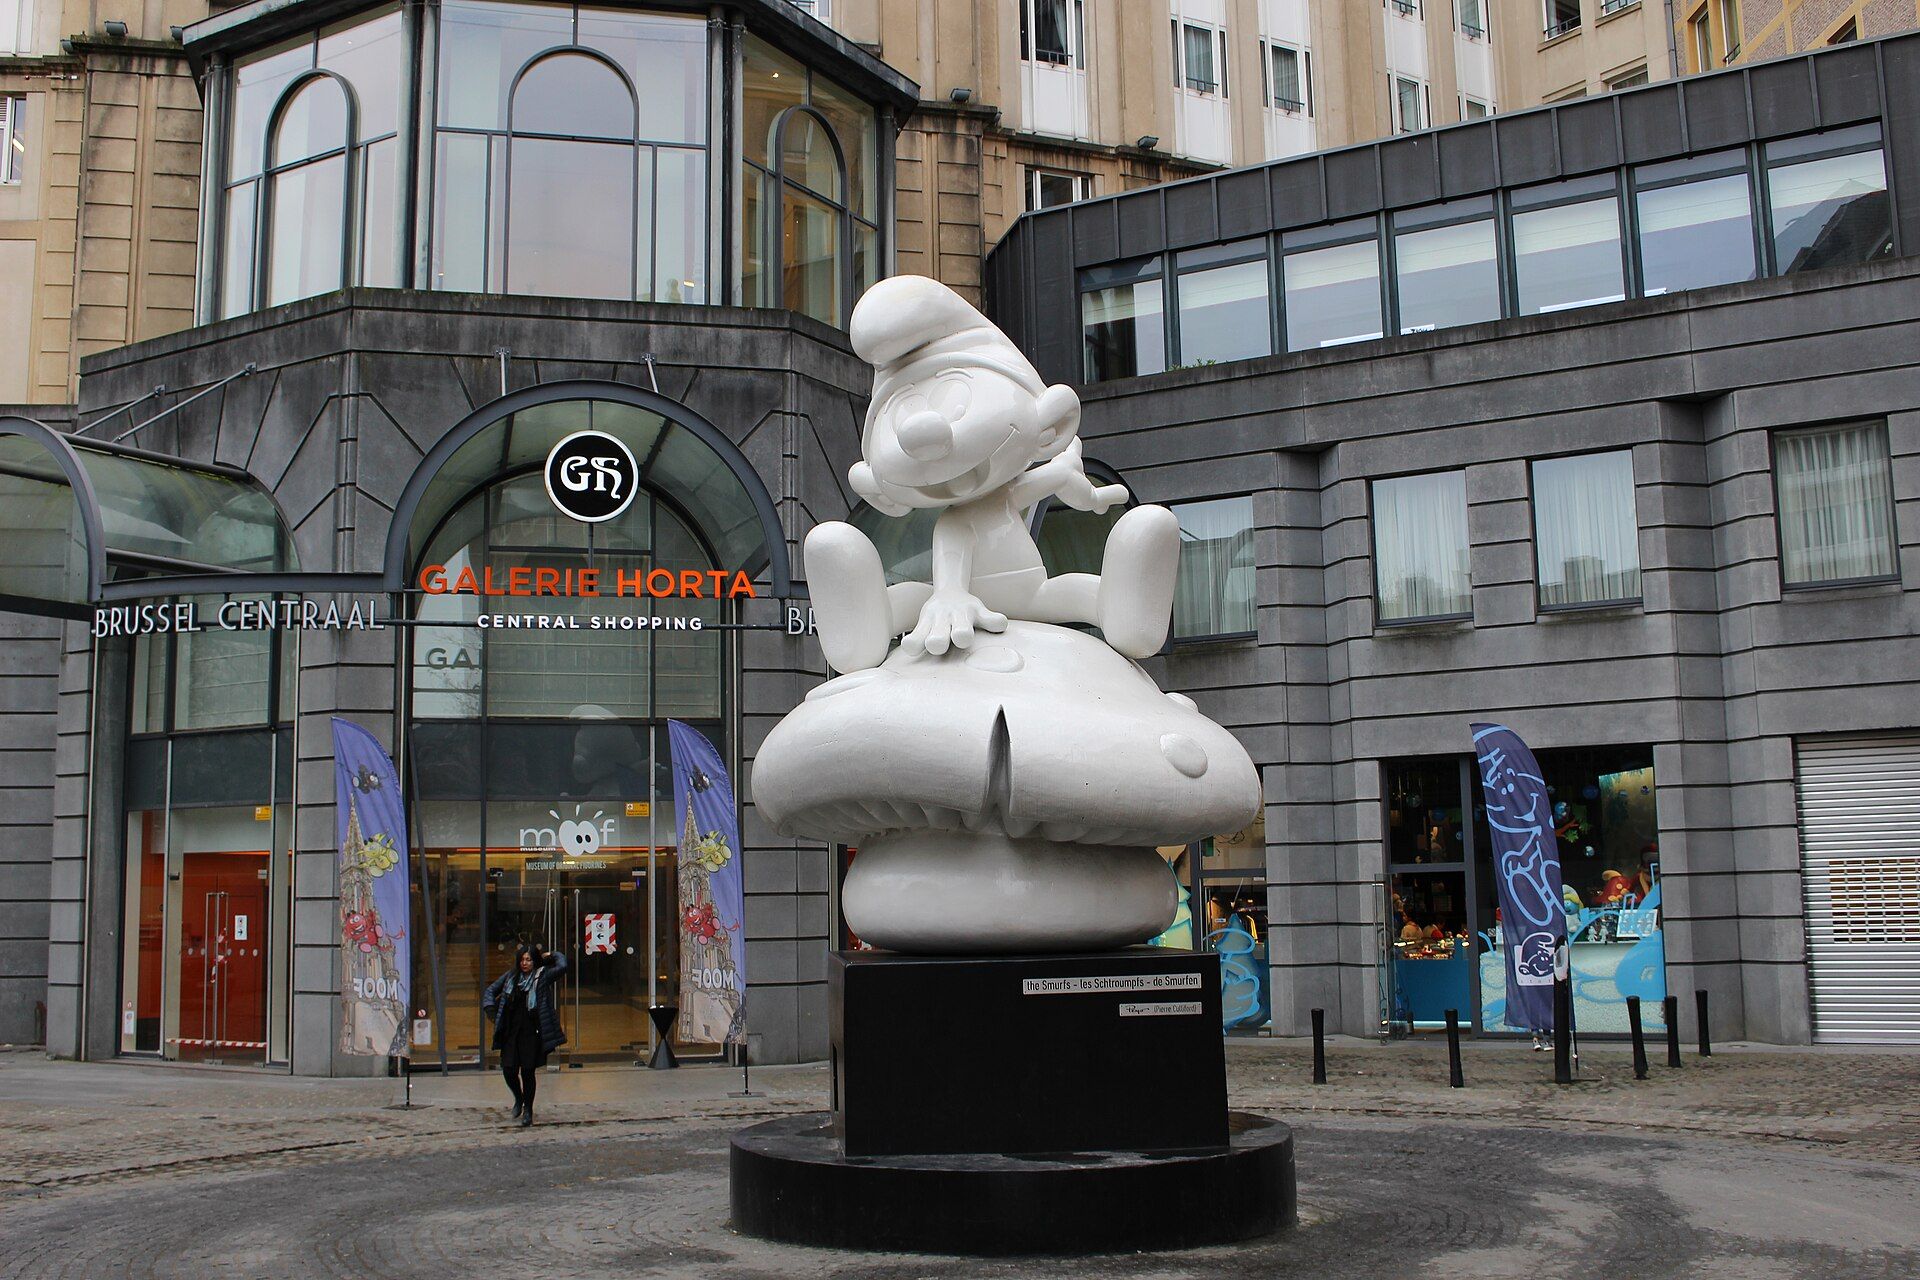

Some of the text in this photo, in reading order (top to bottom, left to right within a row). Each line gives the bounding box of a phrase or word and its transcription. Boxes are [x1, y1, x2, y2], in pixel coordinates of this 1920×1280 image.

[419, 564, 756, 599] GALERIE HORTA
[95, 600, 385, 638] BRUSSEL CENTRAAL
[477, 614, 702, 631] CENTRAL SHOPPING
[525, 861, 549, 871] MUSEUM
[1027, 981, 1040, 991] the
[1042, 979, 1071, 990] Smurfs
[1080, 978, 1092, 989] les
[1094, 976, 1145, 990] Schtroumpfs
[1153, 976, 1163, 987] de
[1165, 975, 1198, 986] Smurfen
